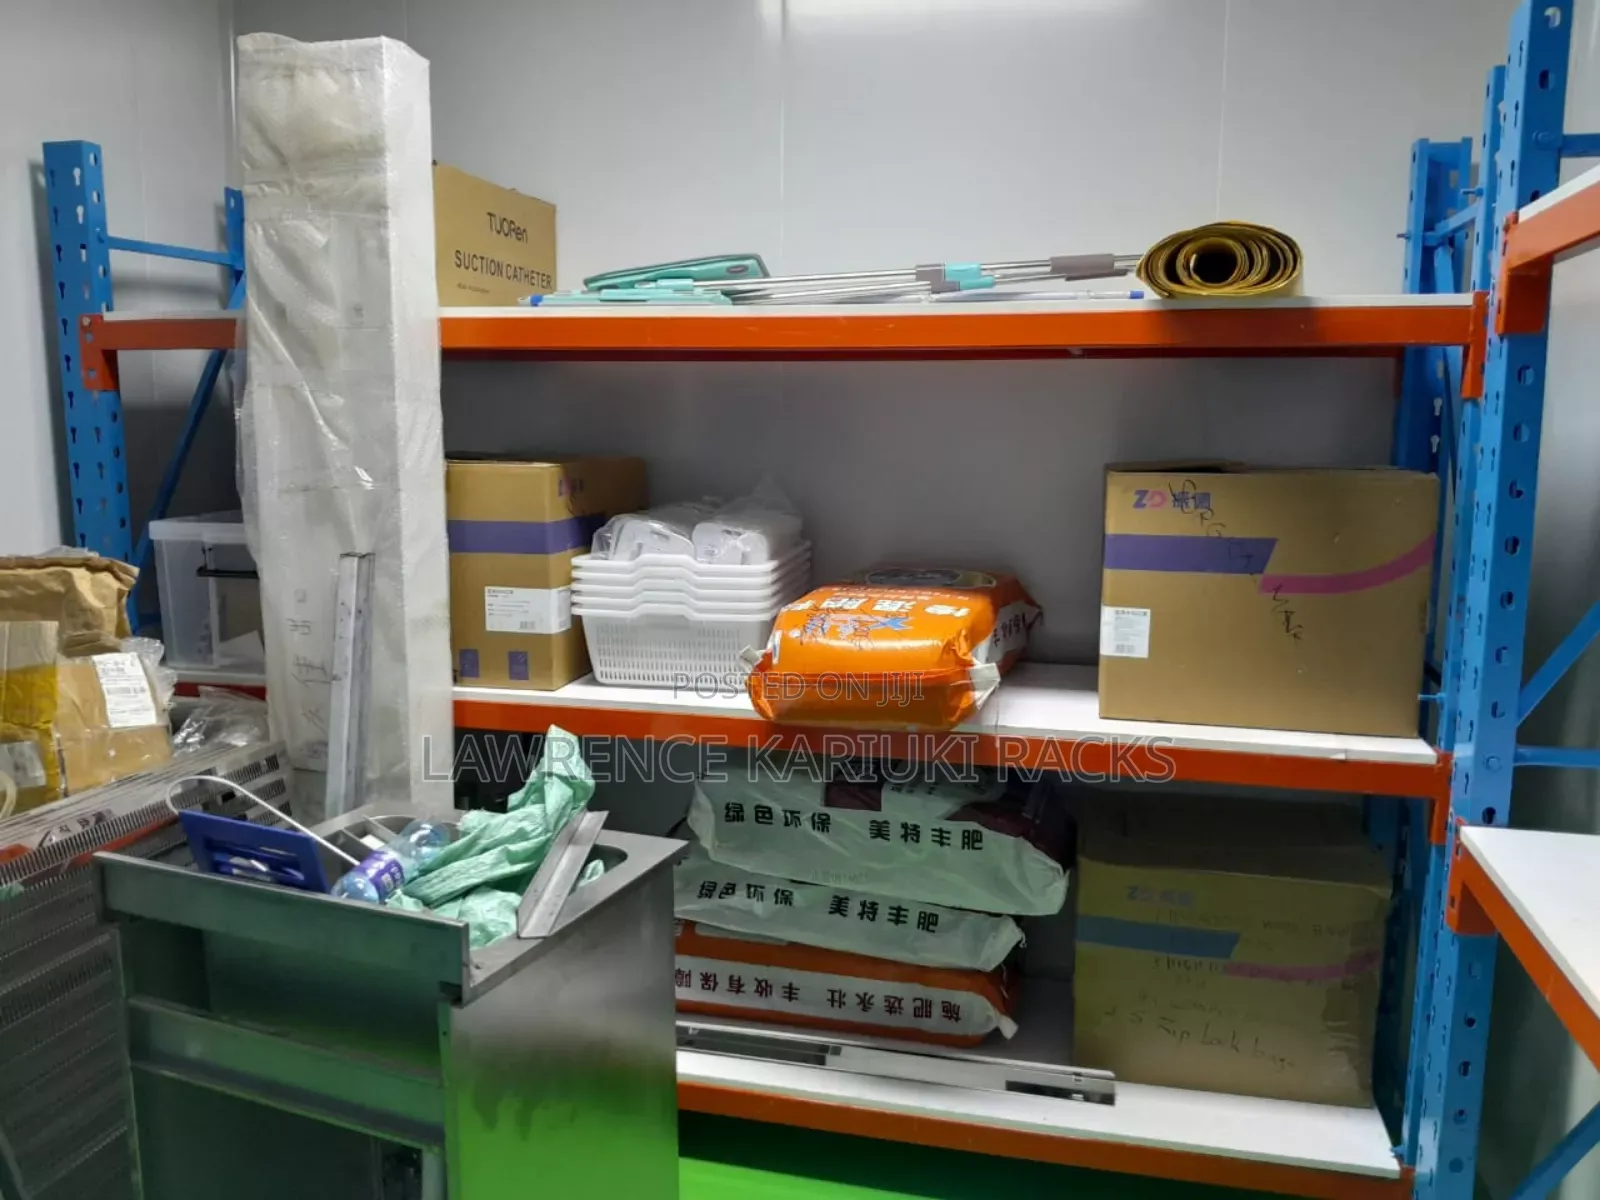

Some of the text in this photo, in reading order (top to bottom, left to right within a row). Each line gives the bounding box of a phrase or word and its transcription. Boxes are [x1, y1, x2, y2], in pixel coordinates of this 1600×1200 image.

[453, 249, 505, 279] SUCTION
[505, 262, 553, 290] CATHETER
[723, 801, 985, 851] 绿色环保 美特丰肥
[698, 879, 940, 933] 绿色环保 美特丰肥
[826, 987, 962, 1023] 施肥选永壮
